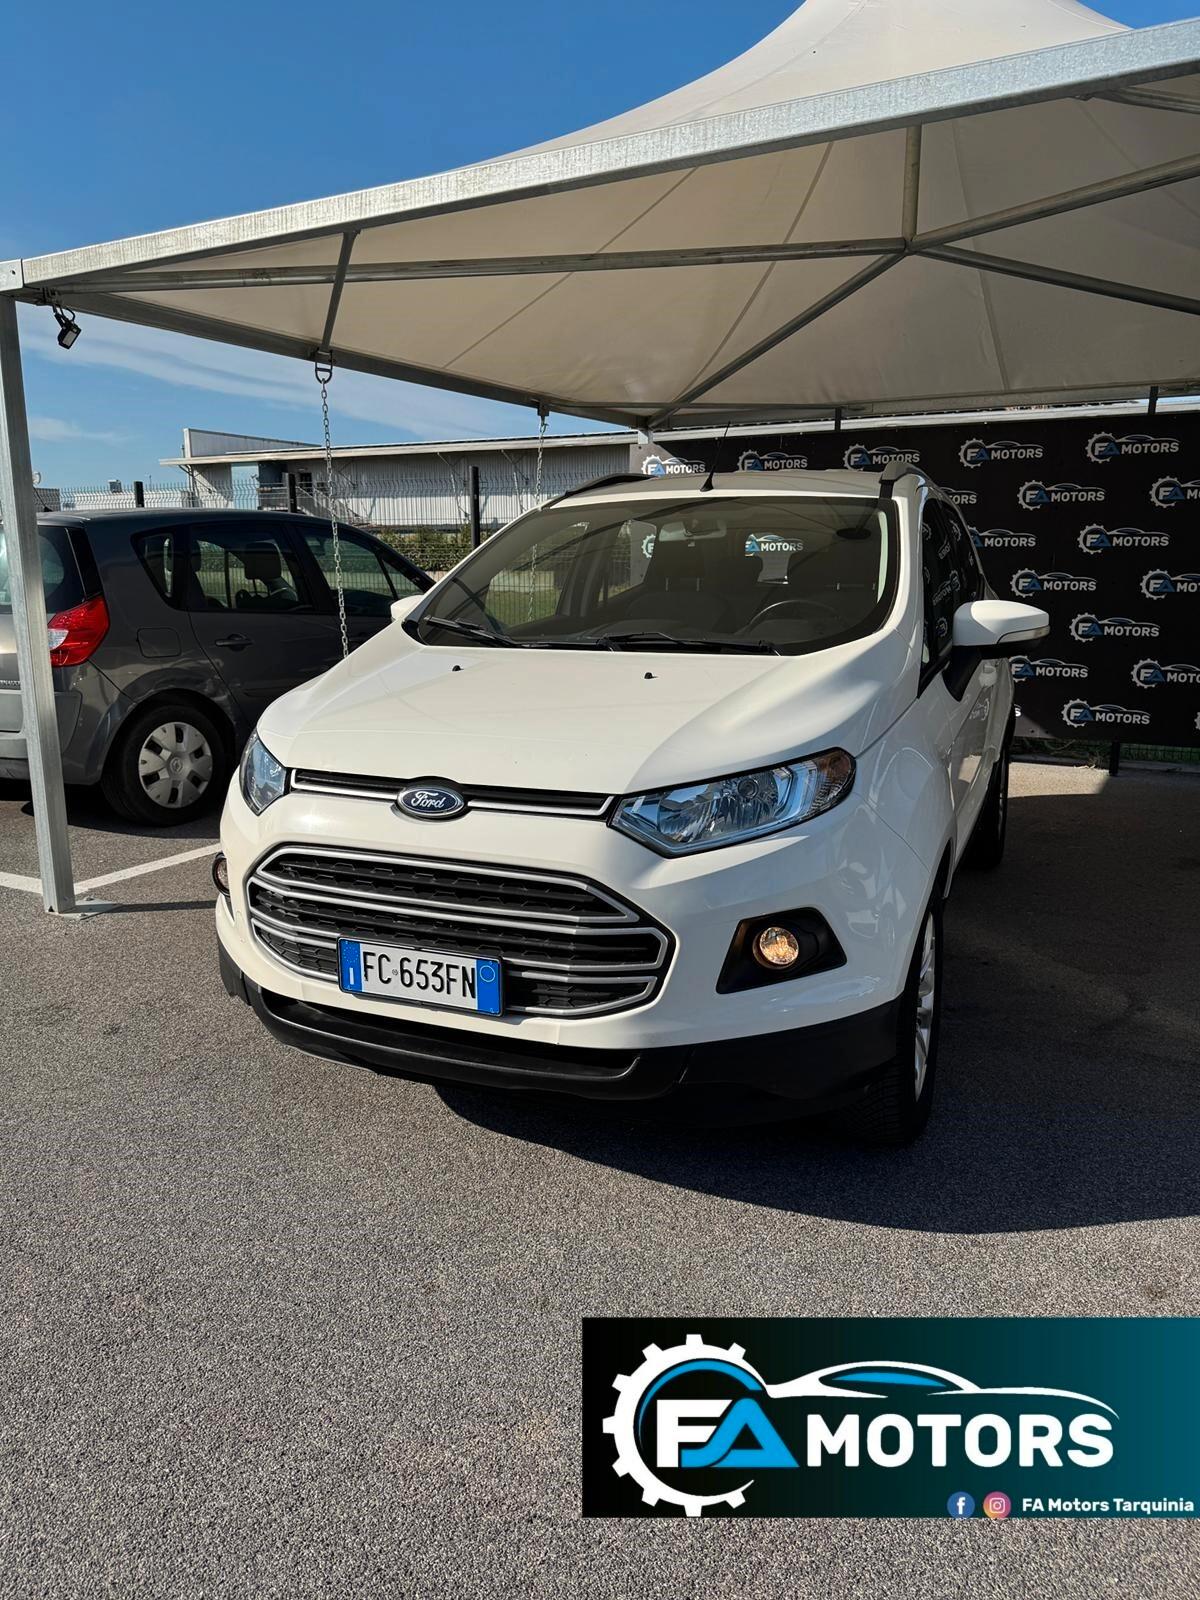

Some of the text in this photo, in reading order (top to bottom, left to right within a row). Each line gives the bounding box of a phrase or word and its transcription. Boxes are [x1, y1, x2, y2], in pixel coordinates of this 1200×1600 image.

[966, 448, 1043, 461] FA MOTORS
[1094, 442, 1180, 456] FA MOTORS
[666, 464, 706, 474] MOTORS
[764, 459, 808, 470] MOTORS
[1025, 490, 1105, 503] FA MOTORS
[760, 542, 804, 552] MOTORS
[984, 537, 1036, 547] MOTORS
[1086, 535, 1169, 548] FA MOTORS
[1019, 578, 1096, 591] FA MOTORS
[1149, 580, 1175, 592] FA
[1078, 622, 1160, 637] FA MOTORS
[1011, 664, 1088, 678] FA MOTORS
[1140, 669, 1165, 682] FA
[1070, 708, 1150, 725] FA MOTORS
[411, 791, 446, 808] Ford
